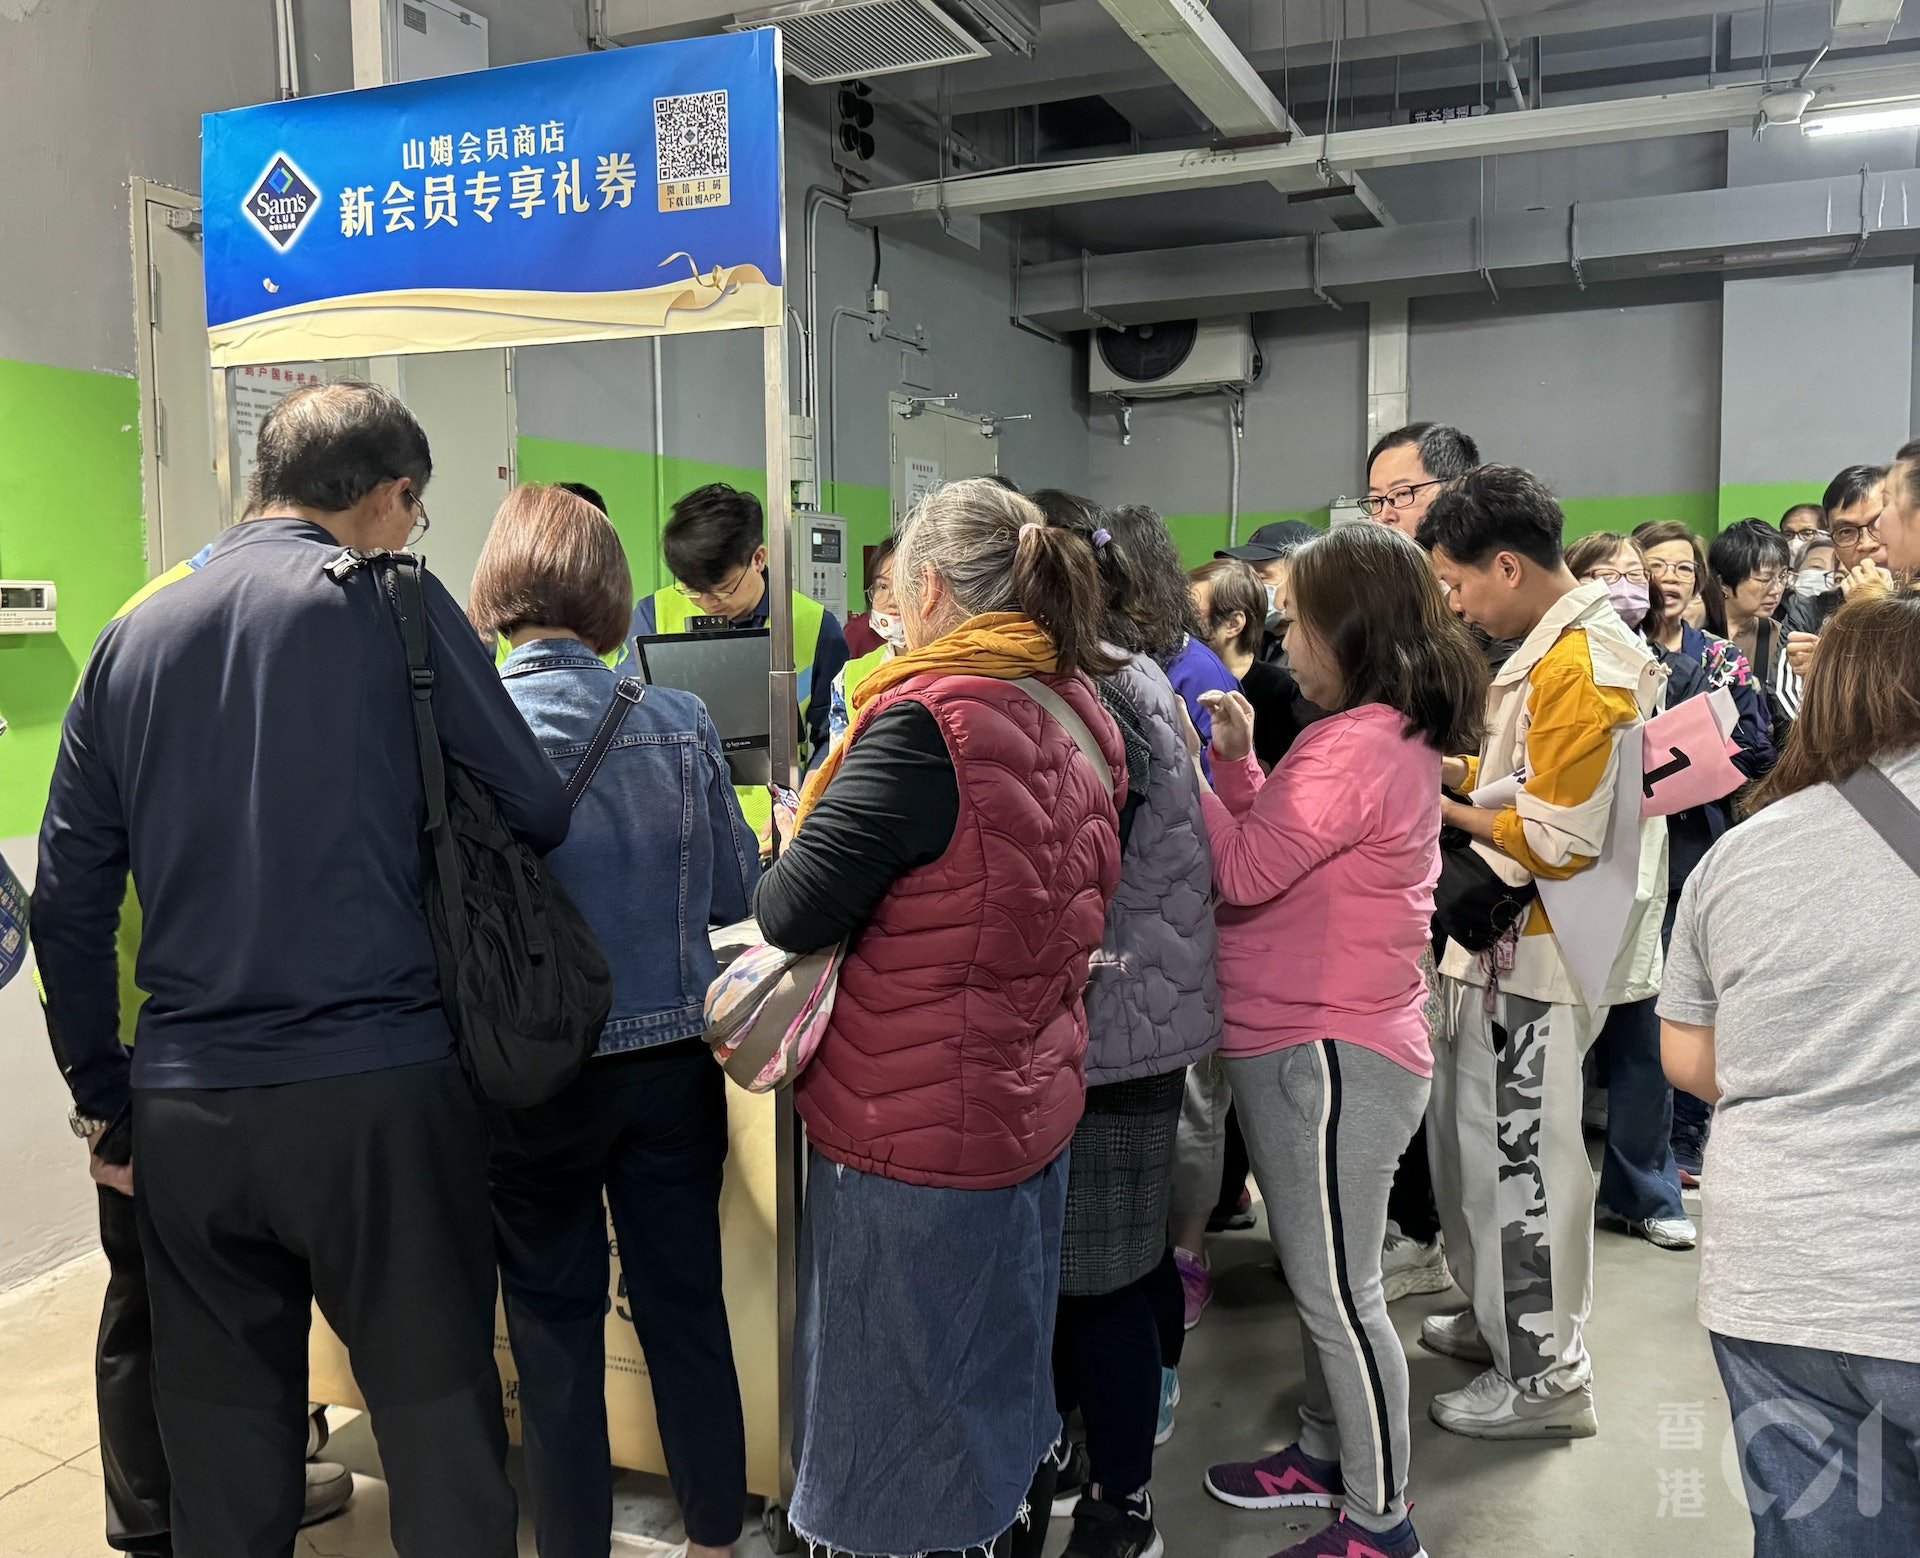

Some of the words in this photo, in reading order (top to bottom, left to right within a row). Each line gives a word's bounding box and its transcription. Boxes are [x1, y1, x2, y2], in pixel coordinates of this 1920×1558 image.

[402, 120, 565, 170] 山姆会员商店
[256, 192, 307, 217] Sam's
[339, 152, 637, 238] 新会员专享礼券
[667, 179, 721, 196] 微信扫码
[269, 213, 296, 224] CLUB
[1643, 746, 1691, 798] 1
